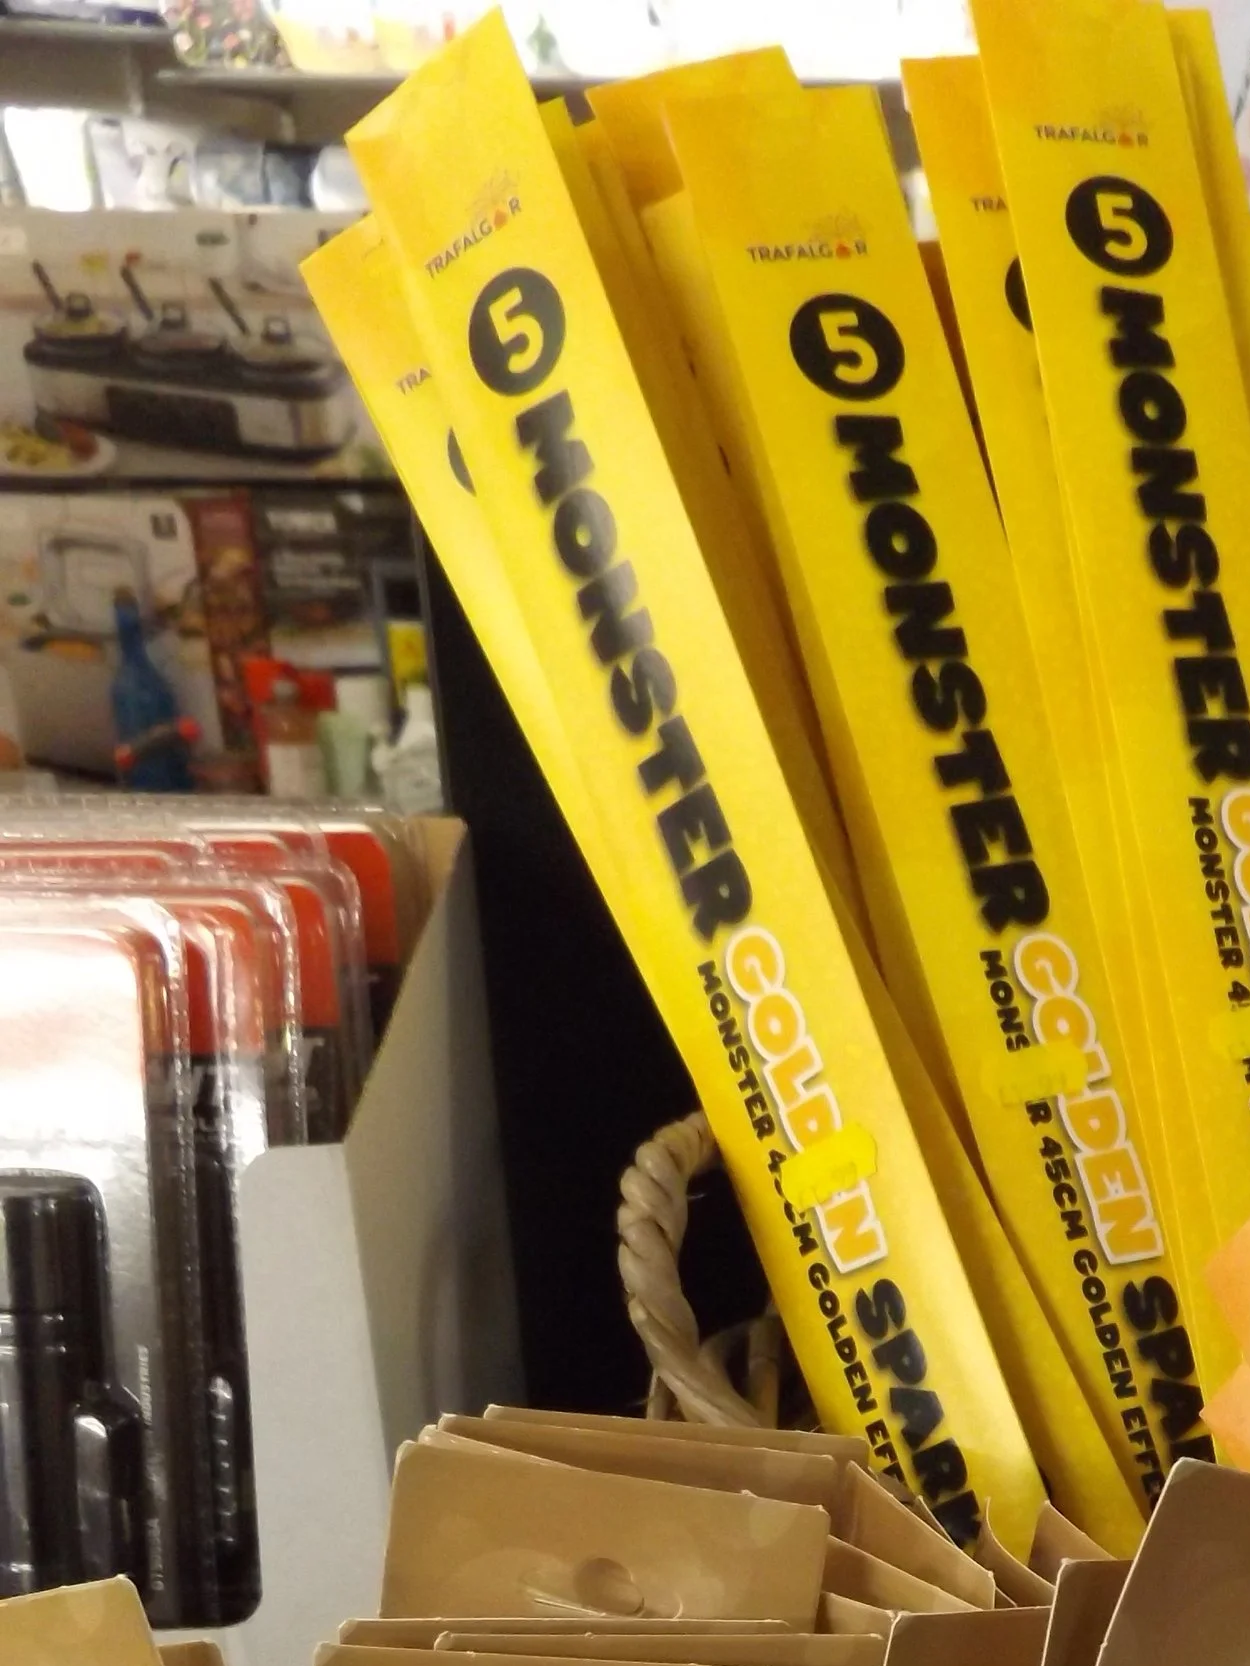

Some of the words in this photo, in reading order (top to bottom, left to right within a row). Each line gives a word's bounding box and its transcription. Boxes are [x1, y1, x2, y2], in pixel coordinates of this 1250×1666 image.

[489, 288, 544, 374] 5
[1096, 193, 1149, 261] 5
[818, 310, 878, 386] 5
[832, 414, 1051, 936] MONSTER
[514, 389, 753, 946] MONSTER
[725, 925, 889, 1275] GOLDN
[1188, 797, 1244, 971] MONSTER
[697, 960, 776, 1142] MONSTER
[808, 1262, 878, 1416] GOLDEN
[1038, 1135, 1089, 1241] 45CM
[1072, 1248, 1138, 1400] GOLDEN
